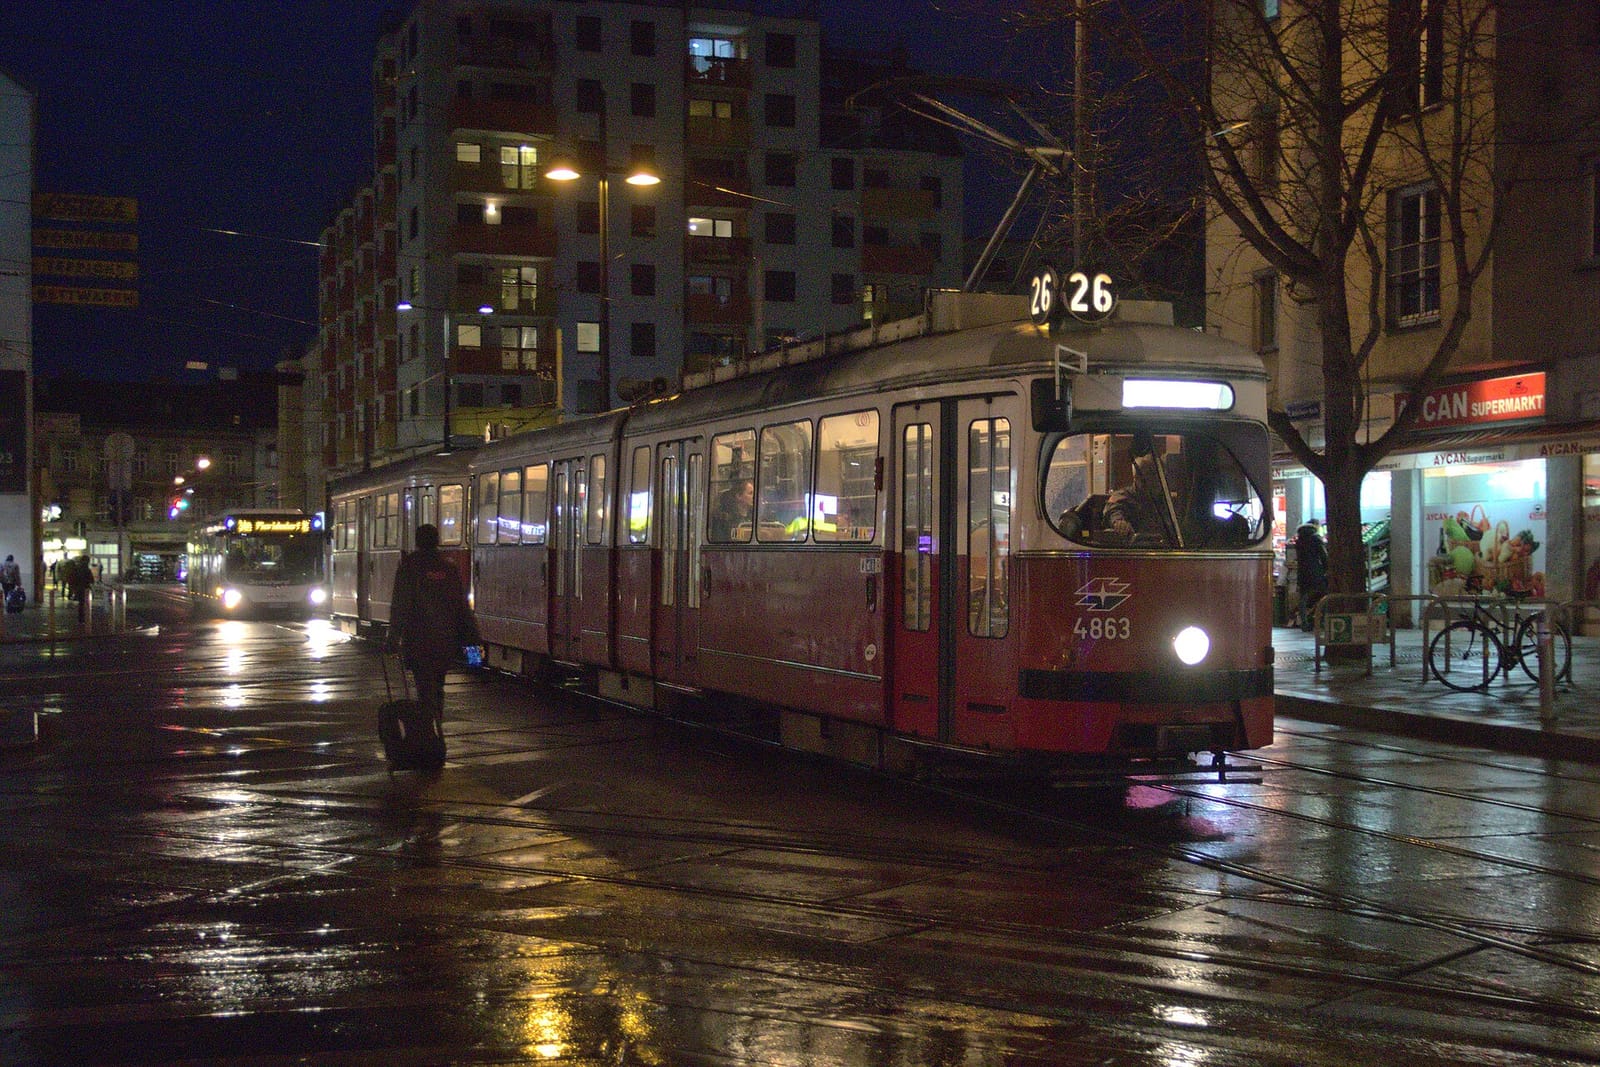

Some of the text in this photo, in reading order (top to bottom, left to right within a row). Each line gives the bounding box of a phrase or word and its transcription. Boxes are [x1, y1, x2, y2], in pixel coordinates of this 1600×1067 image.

[1031, 273, 1051, 314] 26
[1070, 273, 1112, 313] 26
[1472, 395, 1544, 418] SUPERMARKT
[1433, 452, 1505, 466] AYCAN Supermarkt
[1540, 442, 1579, 457] AYCAN
[1073, 616, 1131, 640] 4863
[1330, 618, 1346, 641] P
